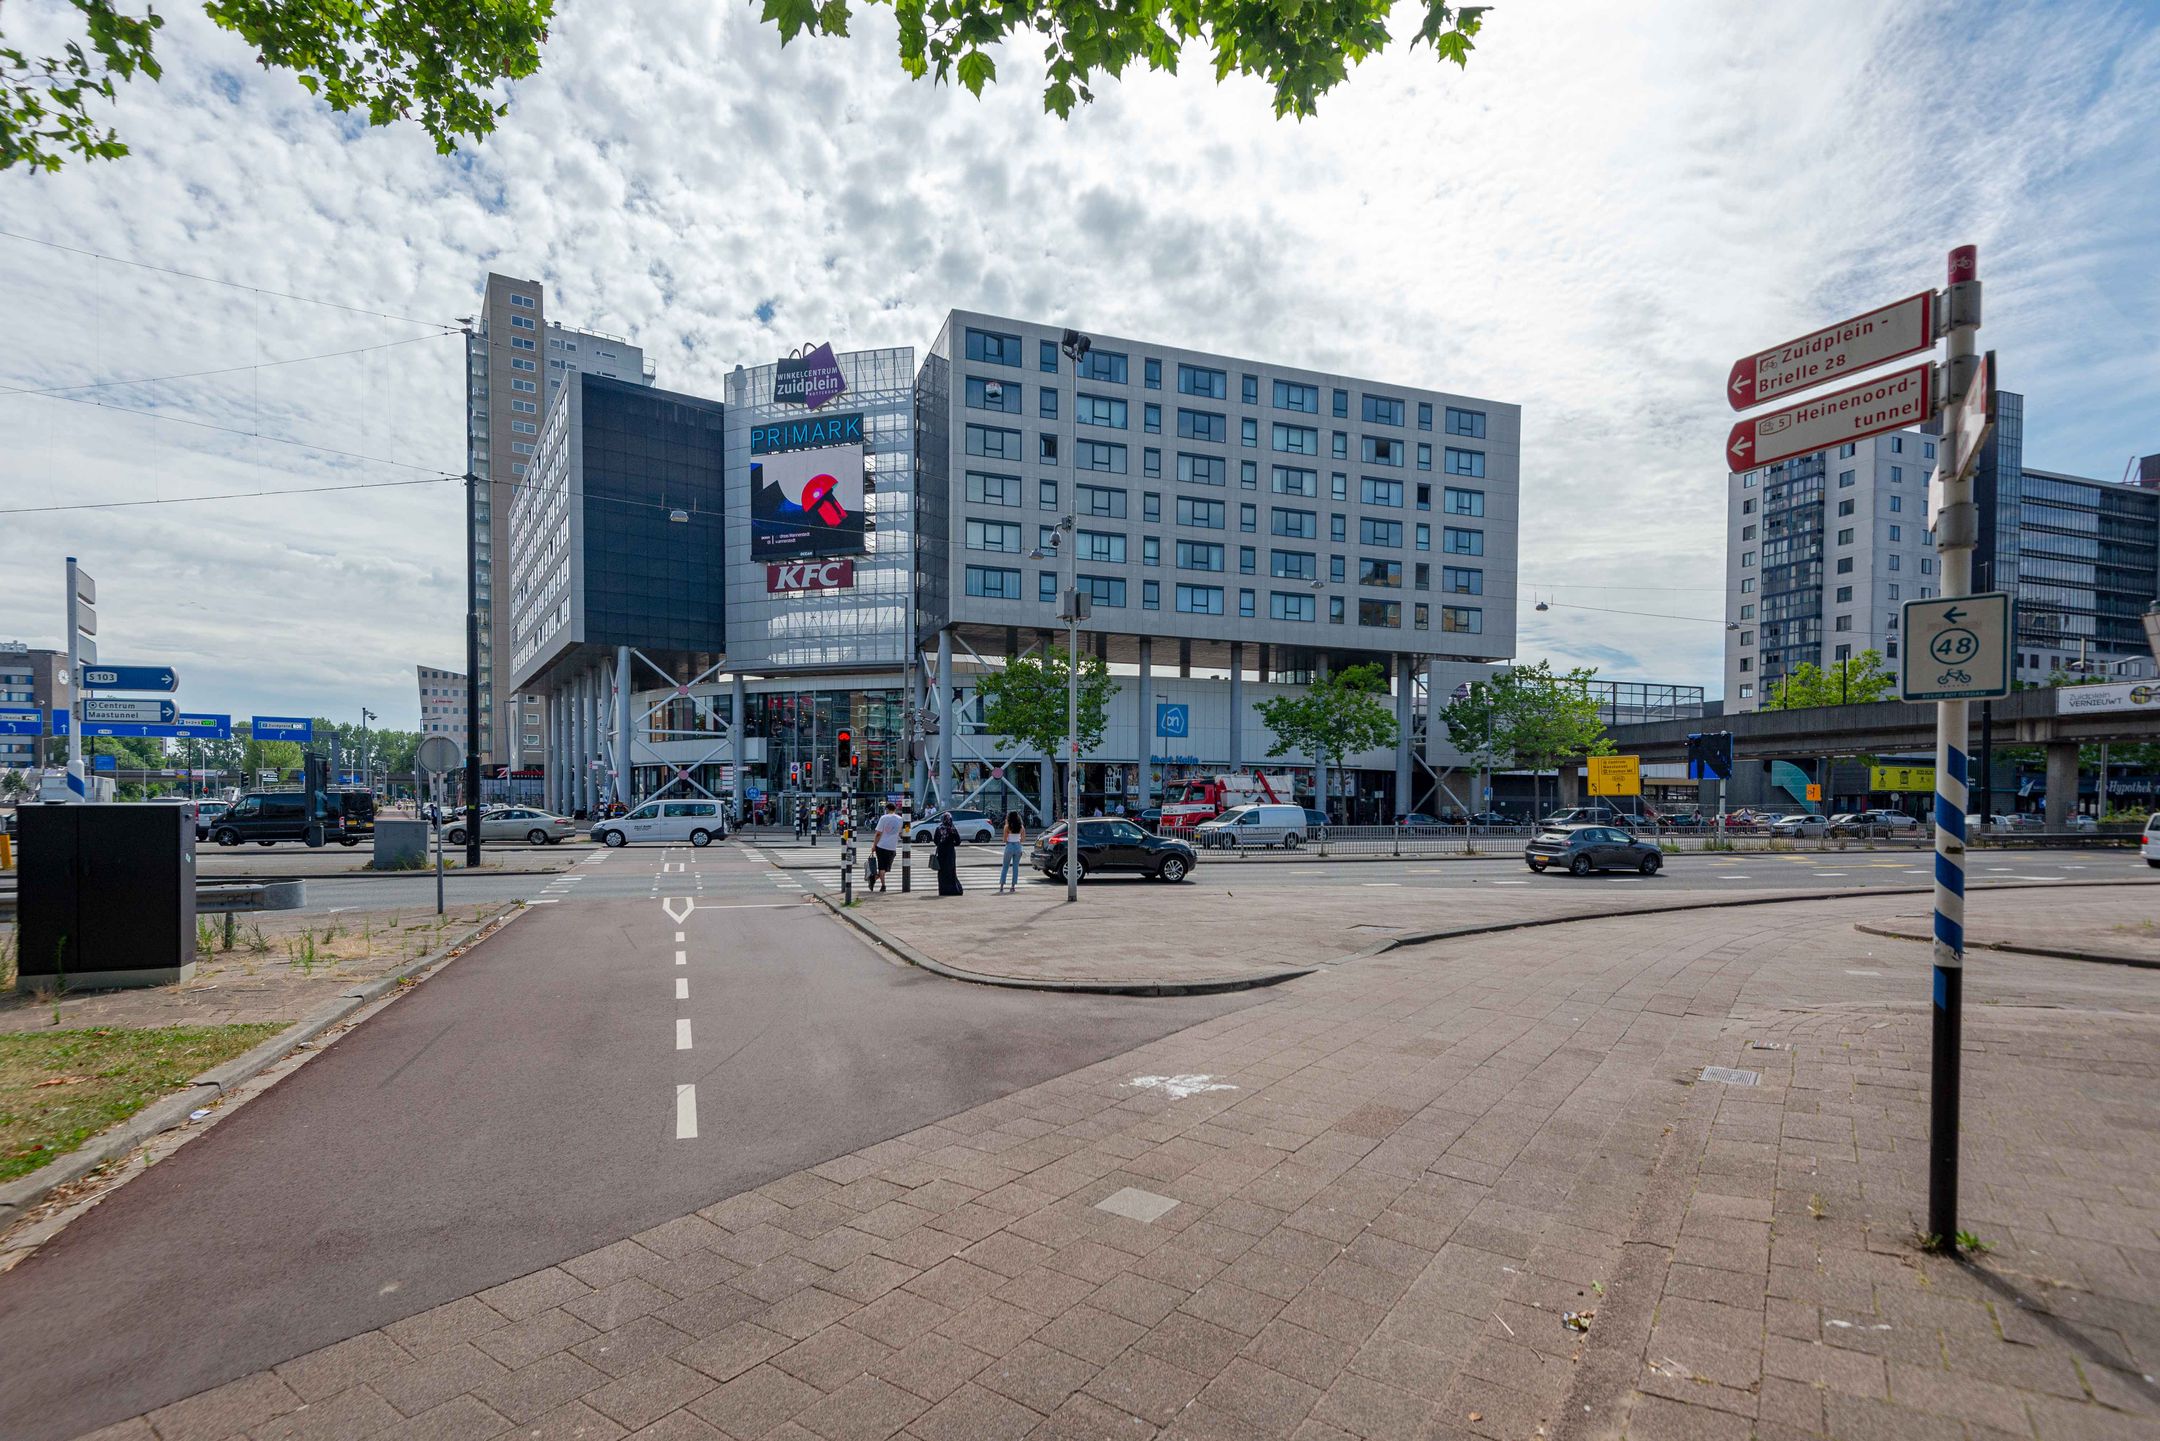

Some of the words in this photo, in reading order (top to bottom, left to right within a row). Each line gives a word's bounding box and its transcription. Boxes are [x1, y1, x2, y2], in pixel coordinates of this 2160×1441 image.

[1782, 321, 1873, 363] Zuidplein
[777, 367, 838, 381] WINKELCENTRUM
[1760, 364, 1818, 393] Brielle
[1825, 354, 1846, 371] 28
[777, 375, 838, 396] zuidplein
[1778, 417, 1785, 428] 5
[1796, 378, 1918, 423] Heinenoord-
[1855, 398, 1919, 428] tunnel
[752, 417, 860, 449] PRIMARK
[774, 562, 841, 590] KFC
[1936, 637, 1972, 655] 48
[97, 673, 115, 681] 103
[2069, 697, 2123, 708] VERNIEUWT
[2070, 691, 2111, 701] Zuidplein
[88, 711, 139, 719] Maastunnel
